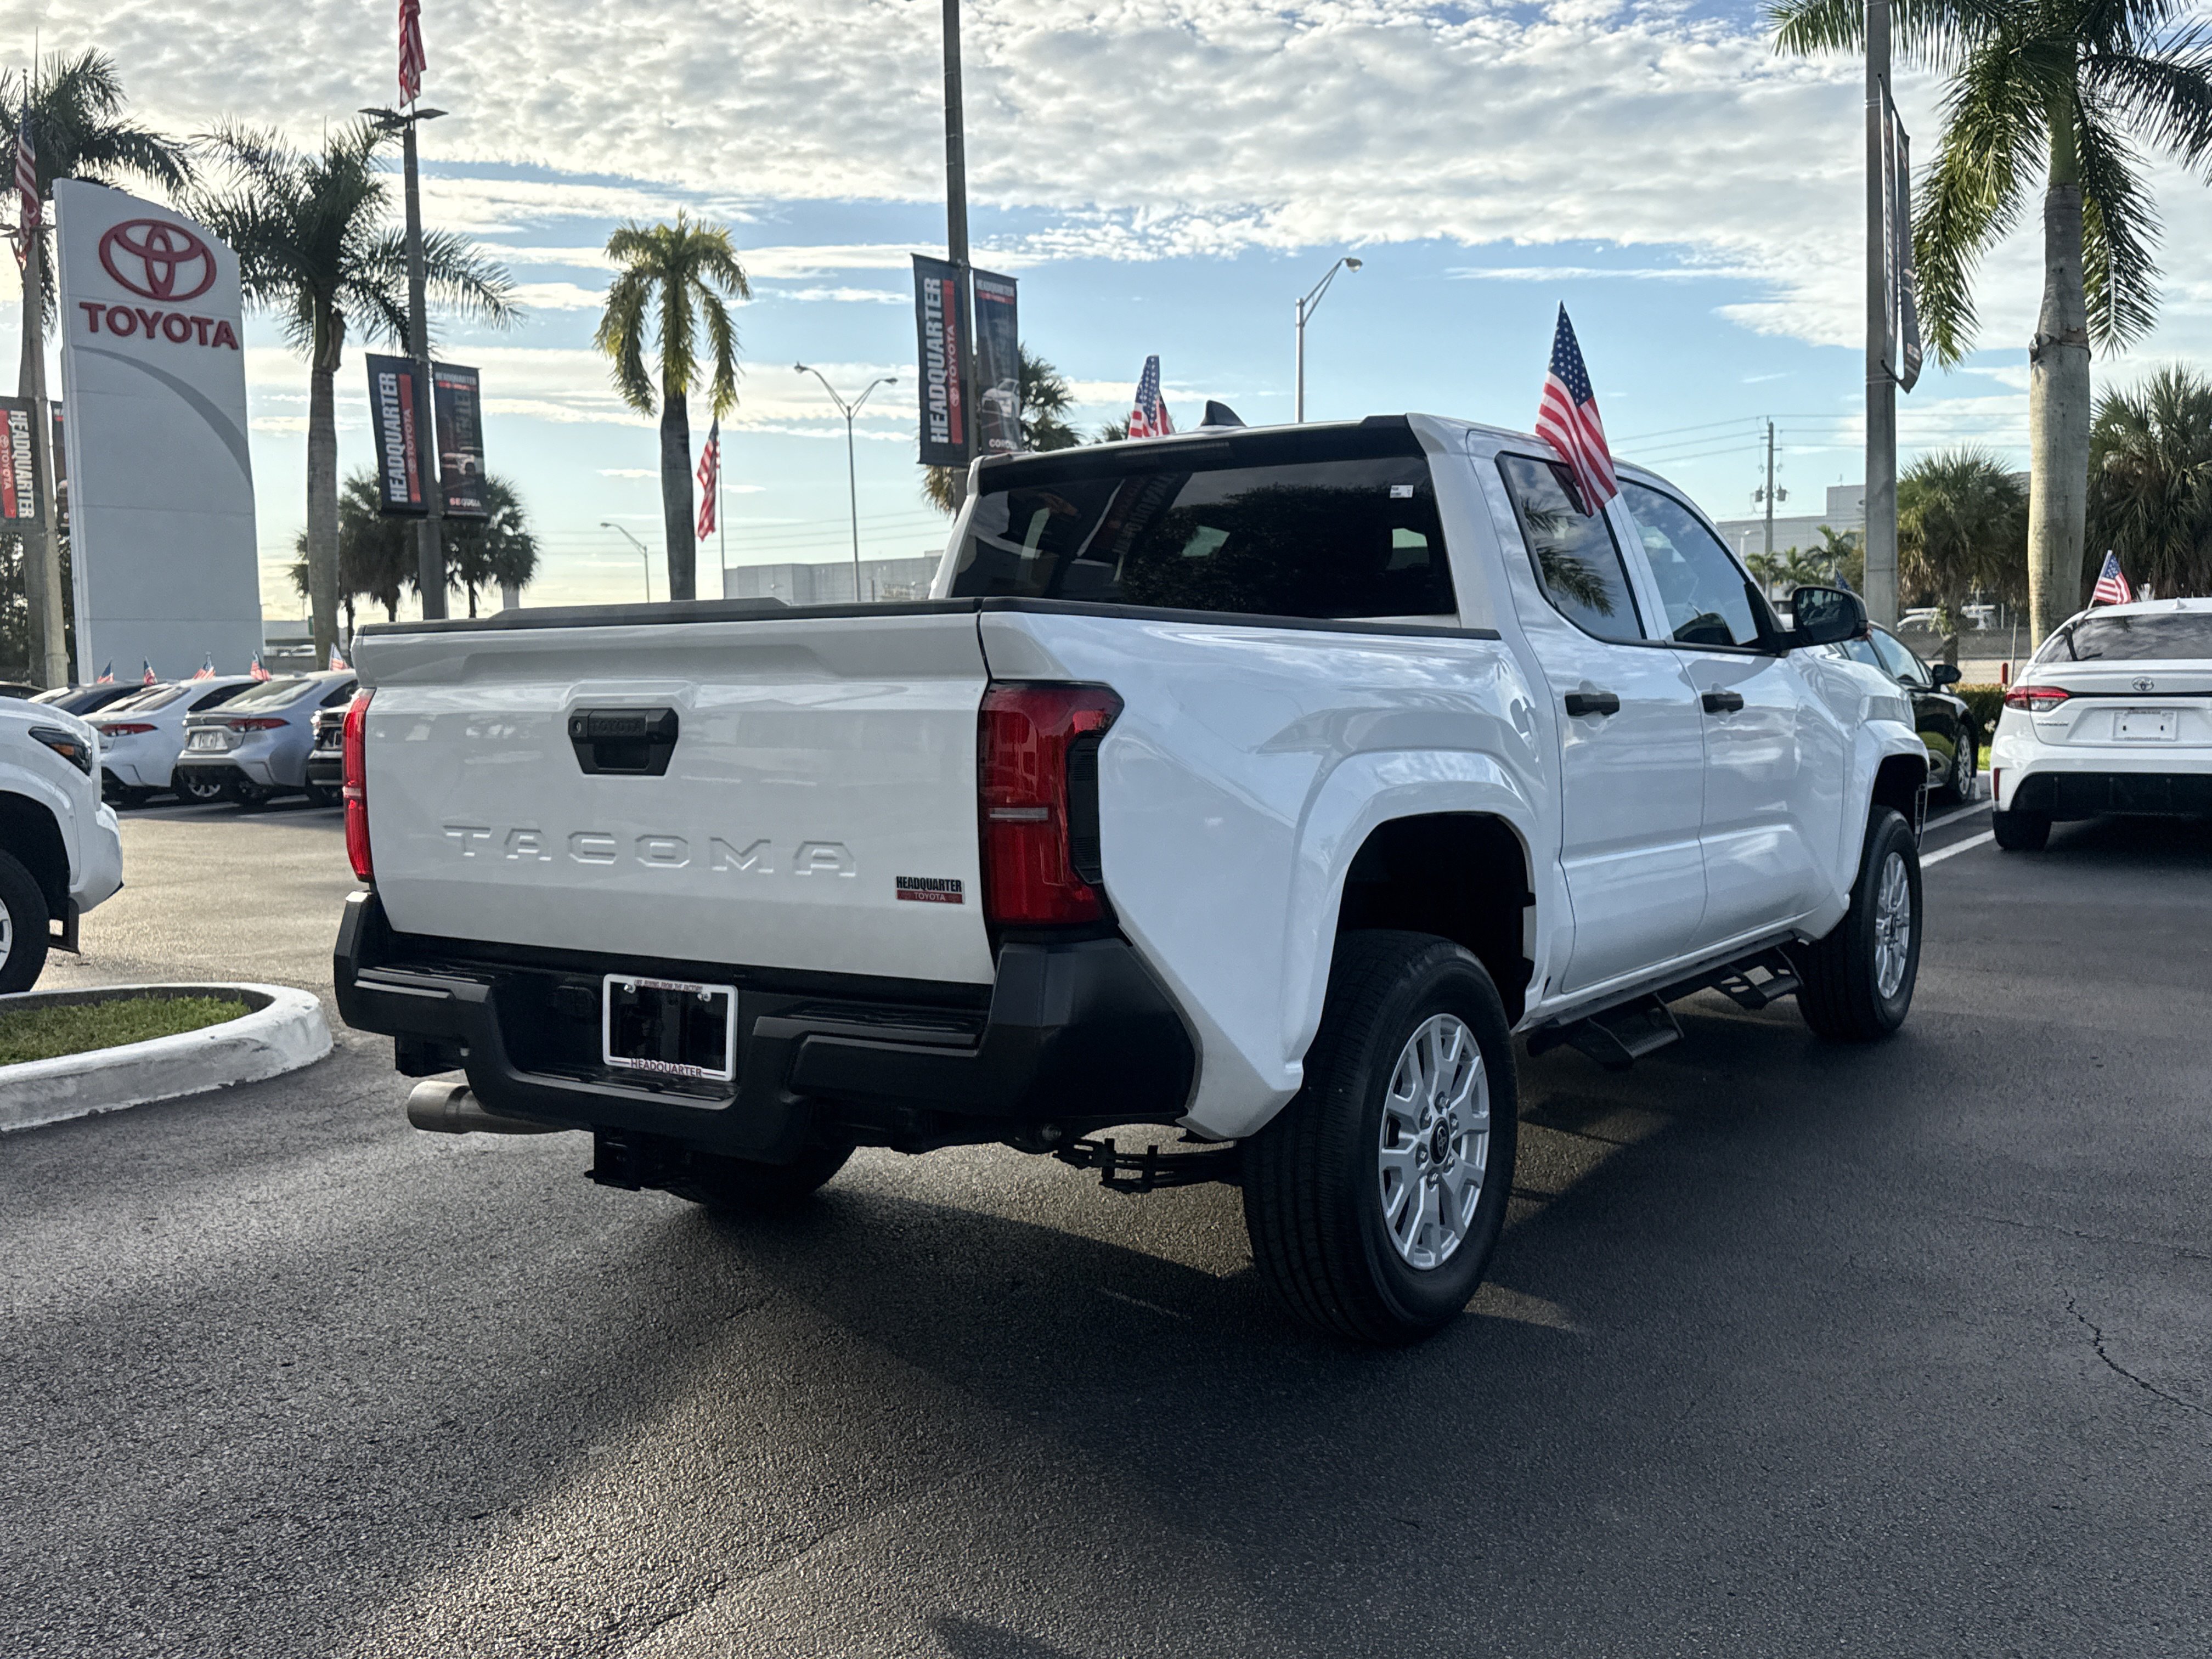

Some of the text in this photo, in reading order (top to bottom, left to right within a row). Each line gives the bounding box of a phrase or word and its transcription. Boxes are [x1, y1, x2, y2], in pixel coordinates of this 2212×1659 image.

[79, 302, 239, 350] TOYOTA
[924, 278, 949, 443] HEADQUARTER
[946, 325, 957, 383] TOYOTA
[379, 372, 408, 503] HEADQUARTER
[403, 409, 415, 456] TOYOTA
[2, 449, 12, 490] TOYOTA
[9, 410, 35, 518] HEADQUARTER
[443, 826, 856, 877] TACOMA
[896, 876, 962, 892] HEADQUARTER
[913, 892, 946, 901] TOYOTA
[631, 1058, 702, 1077] HEADQUARTER
